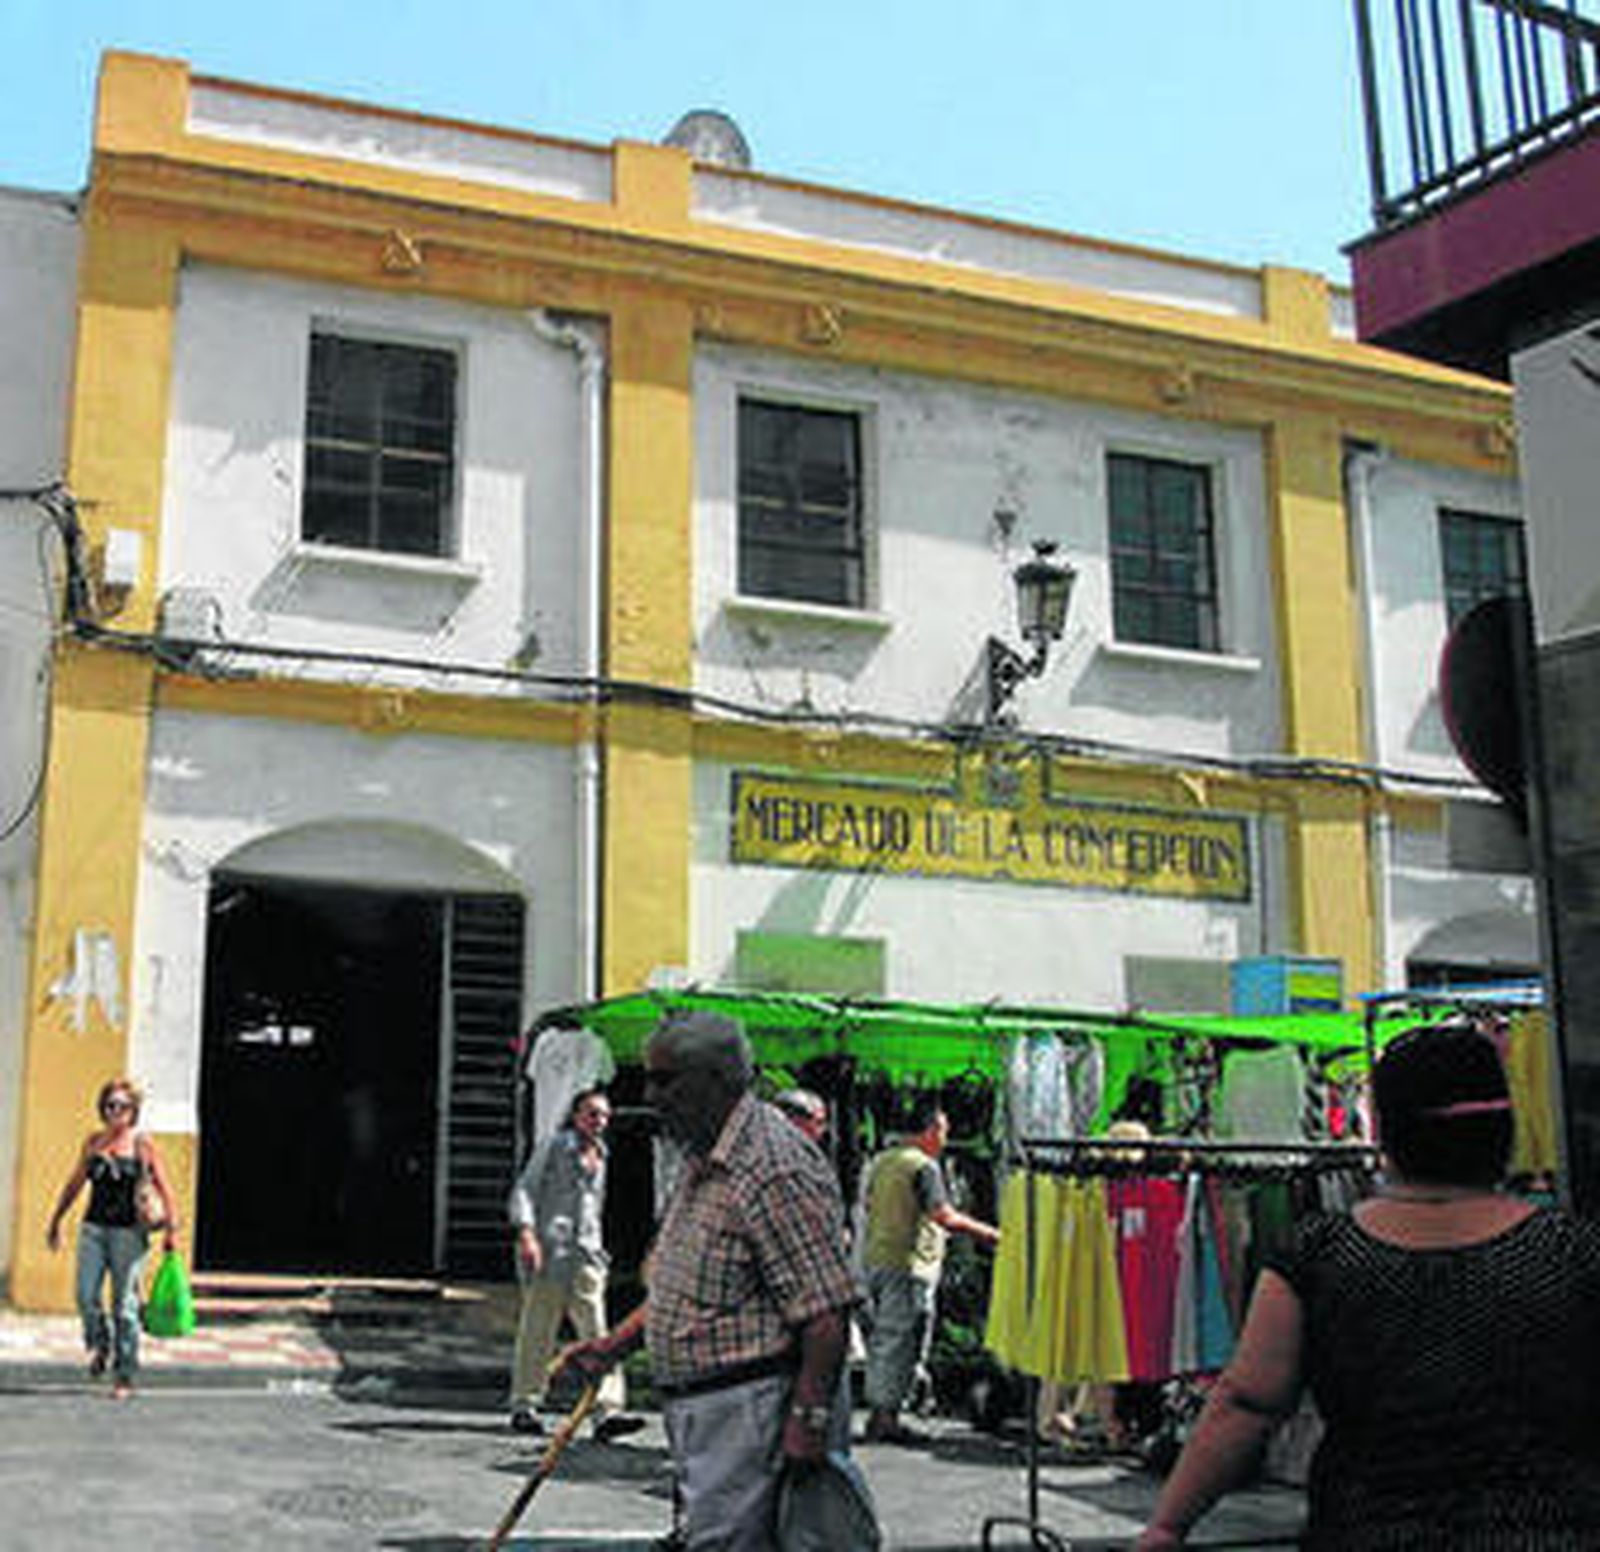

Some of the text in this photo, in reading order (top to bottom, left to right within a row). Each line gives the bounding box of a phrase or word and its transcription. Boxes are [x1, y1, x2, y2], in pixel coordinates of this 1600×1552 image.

[746, 796, 910, 853] MERCADO
[926, 807, 967, 858] DE
[981, 816, 1029, 862] LA
